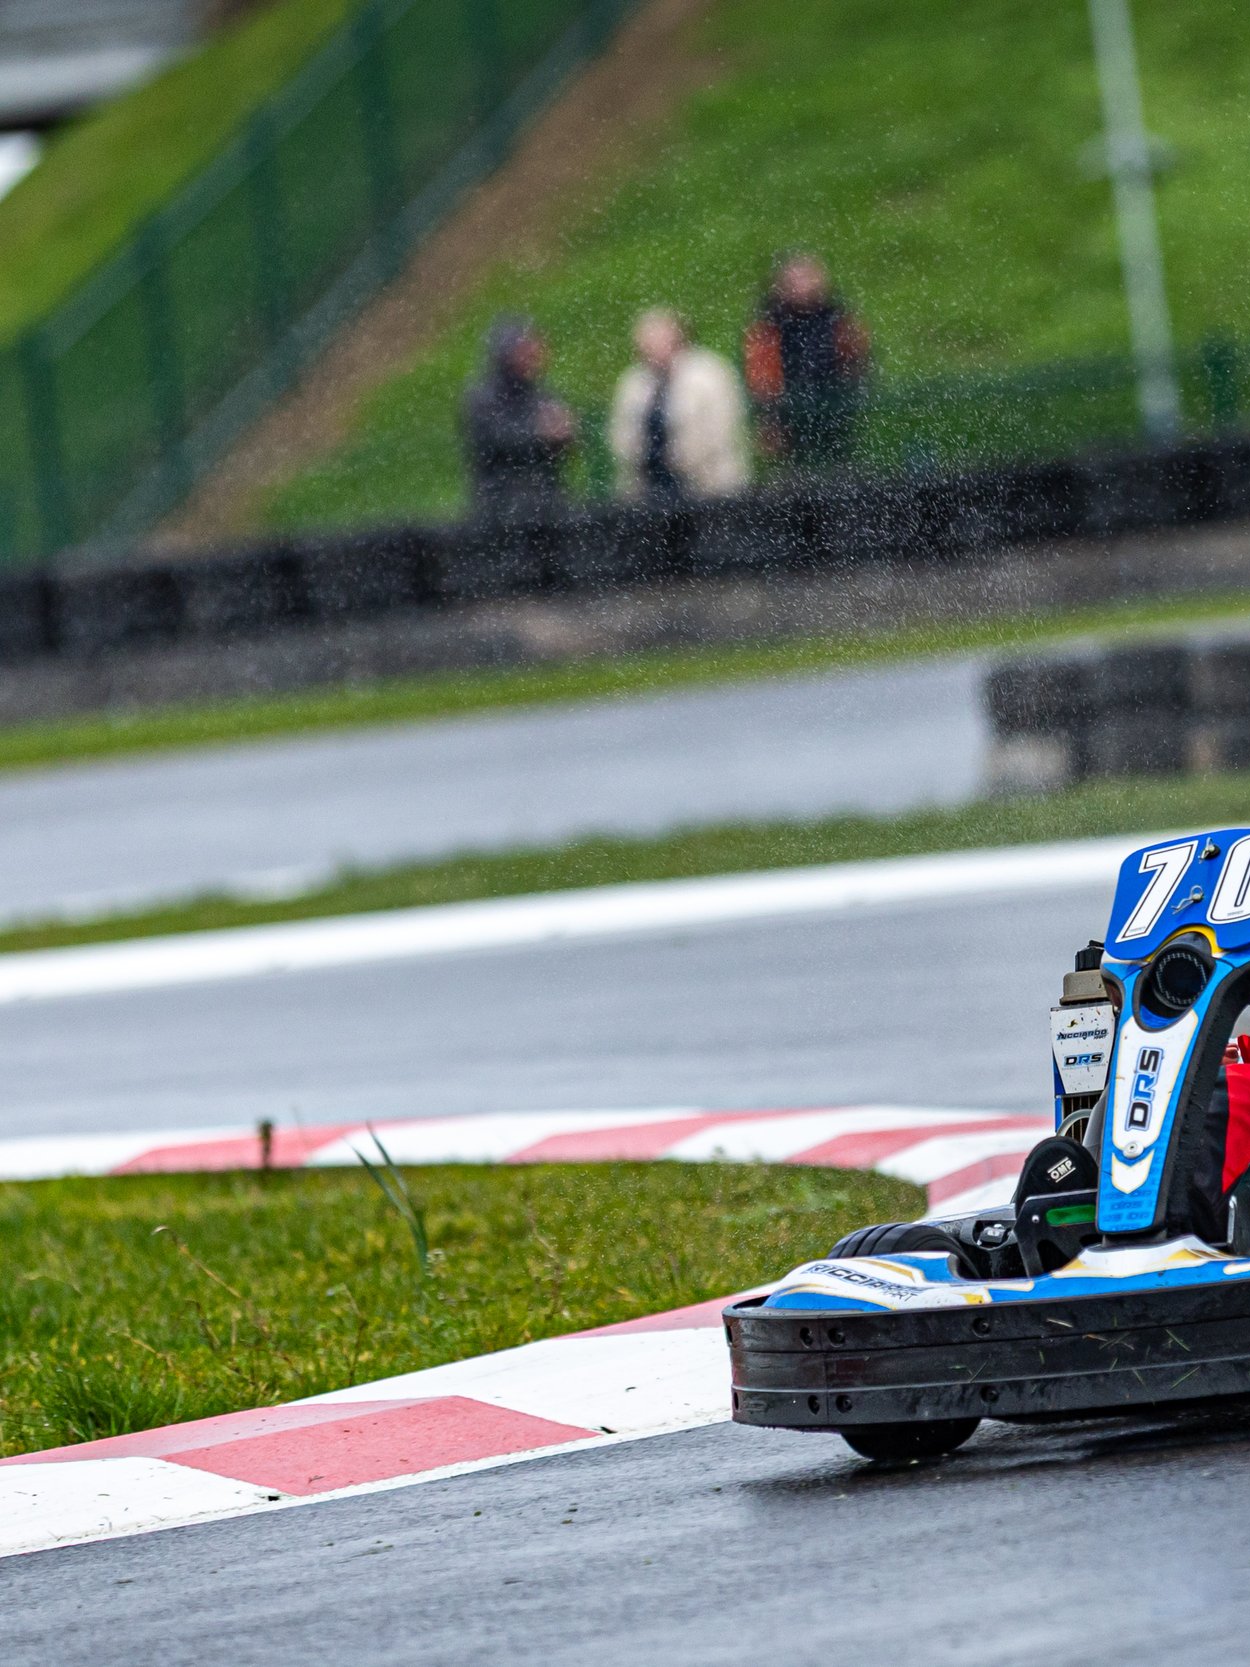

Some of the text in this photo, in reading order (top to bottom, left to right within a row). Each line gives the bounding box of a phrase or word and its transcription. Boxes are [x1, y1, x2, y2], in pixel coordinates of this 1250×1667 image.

[1064, 1053, 1104, 1066] DRS
[1126, 1047, 1163, 1131] DRS
[1050, 1160, 1072, 1180] OMP
